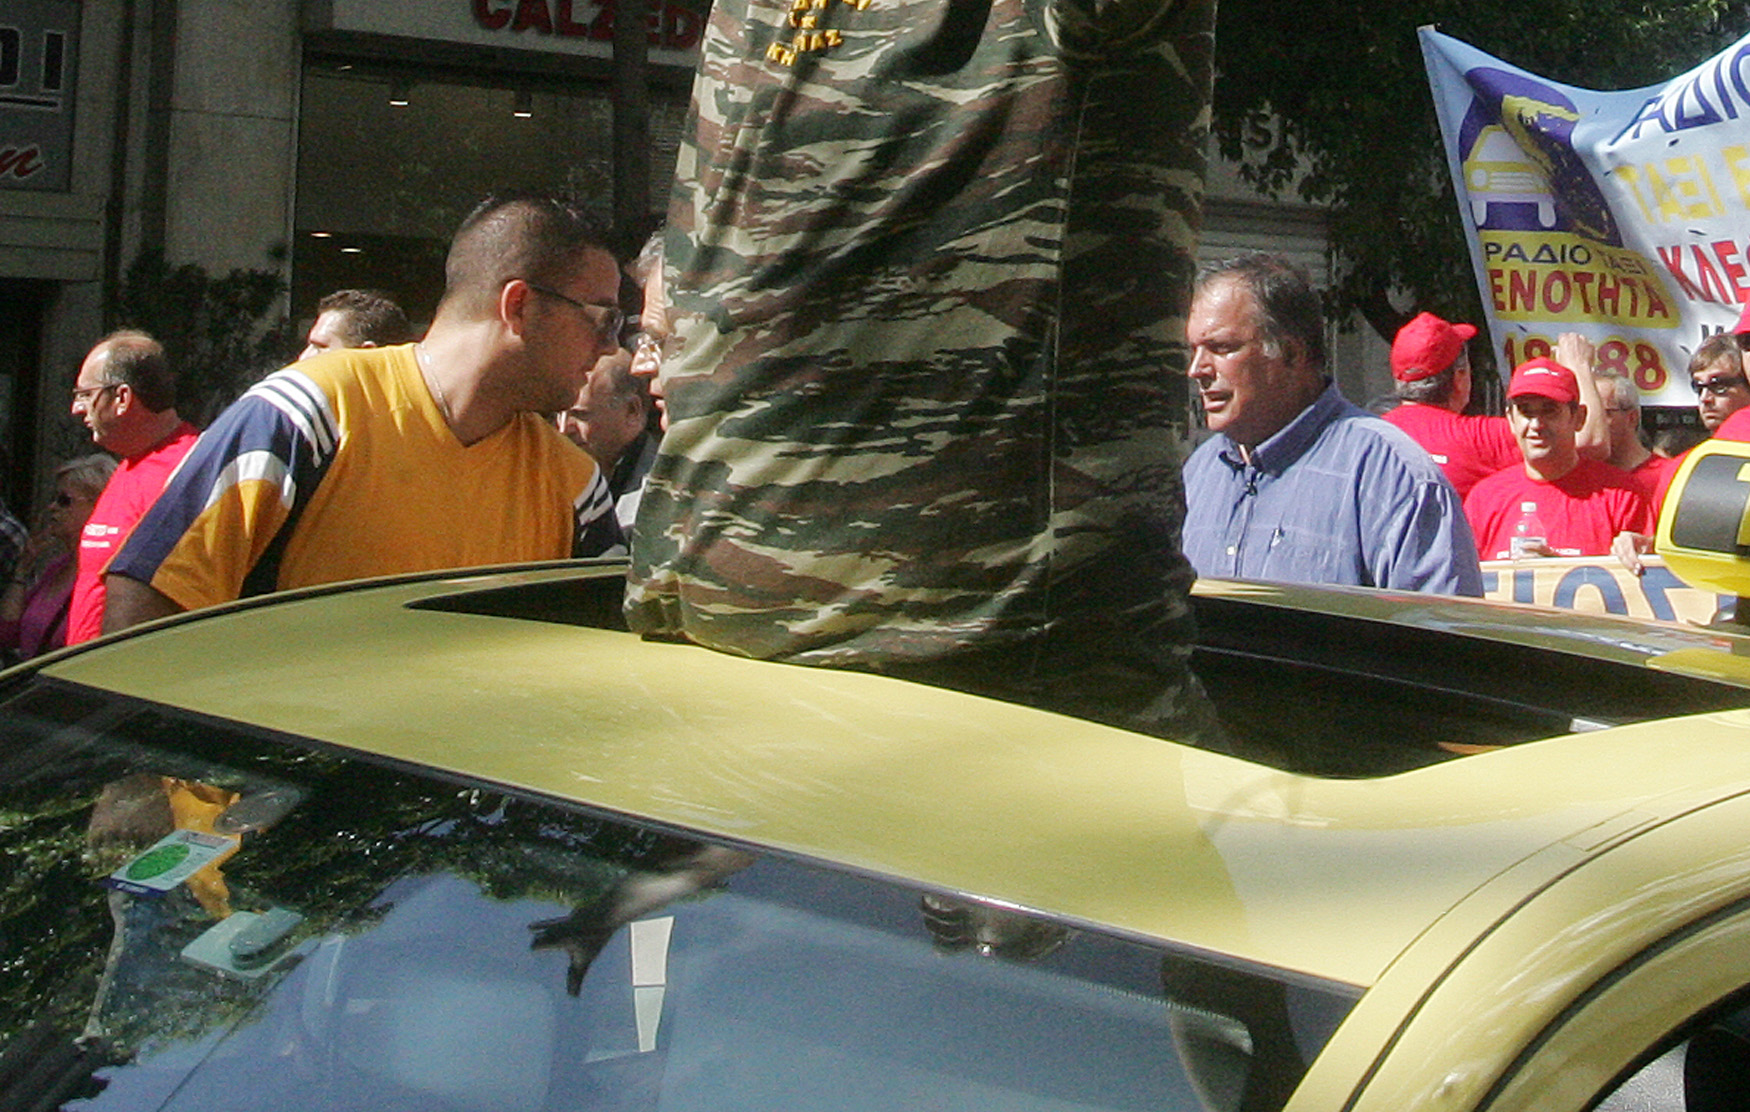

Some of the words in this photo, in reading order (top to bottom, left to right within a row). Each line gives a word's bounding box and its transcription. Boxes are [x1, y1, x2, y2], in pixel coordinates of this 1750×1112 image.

[1614, 155, 1725, 224] ΤΑΞΙ
[1484, 241, 1592, 265] ΡΑΔΙΟ
[1487, 269, 1670, 319] ΕΝΟΤΗΤΑ
[1504, 336, 1667, 391] 1888
